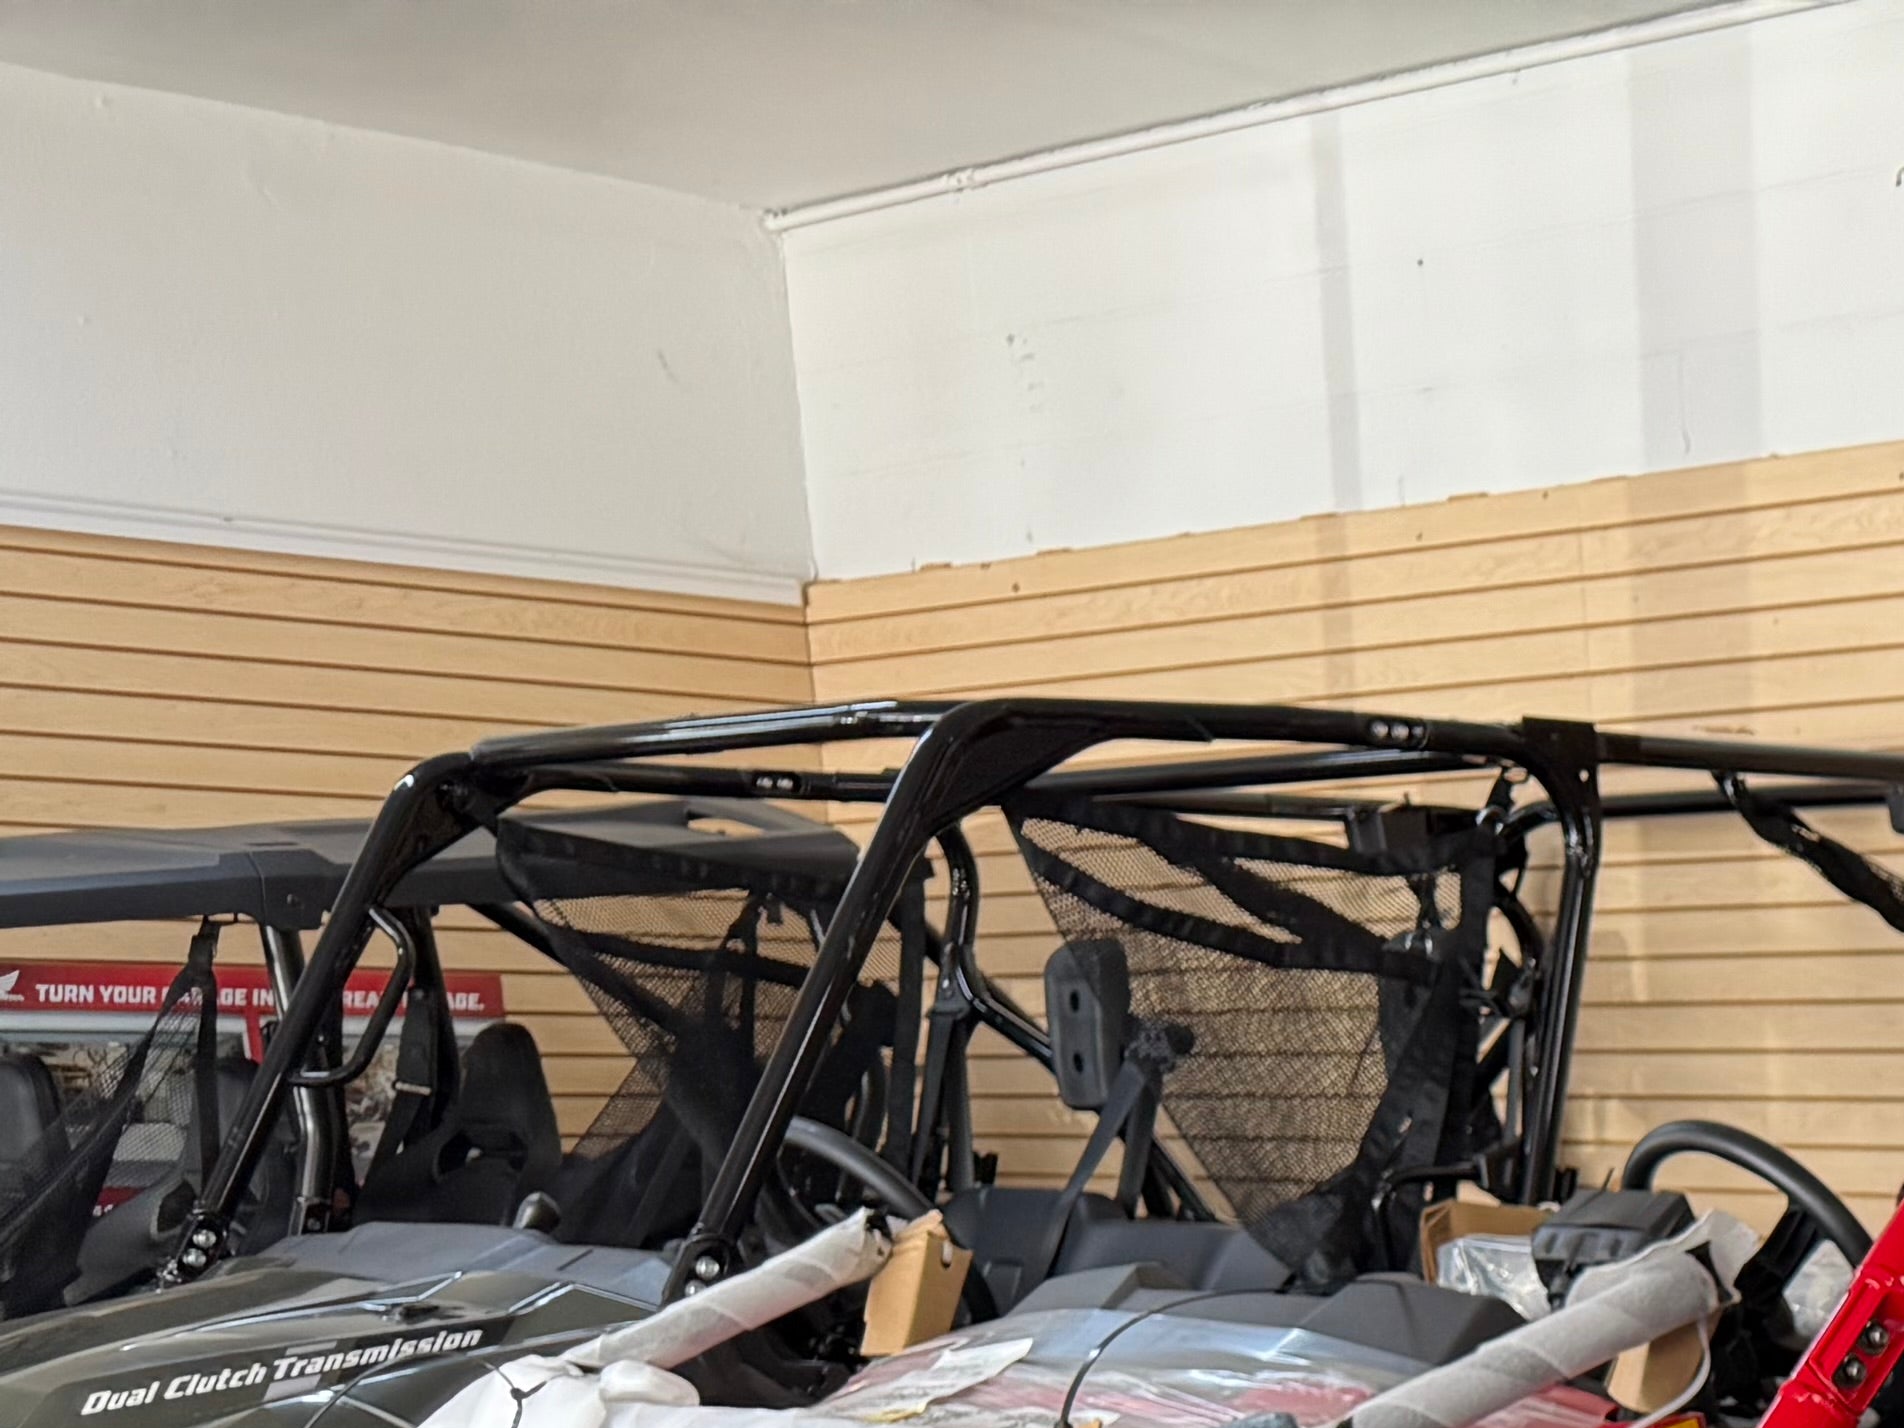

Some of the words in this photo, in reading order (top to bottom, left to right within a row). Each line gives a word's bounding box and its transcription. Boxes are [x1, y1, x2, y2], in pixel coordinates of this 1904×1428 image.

[35, 983, 94, 1004] TURN
[99, 984, 157, 1005] YOUR
[81, 1380, 159, 1416] Dual
[164, 1362, 269, 1400] Clutch
[273, 1328, 483, 1381] Transmission
